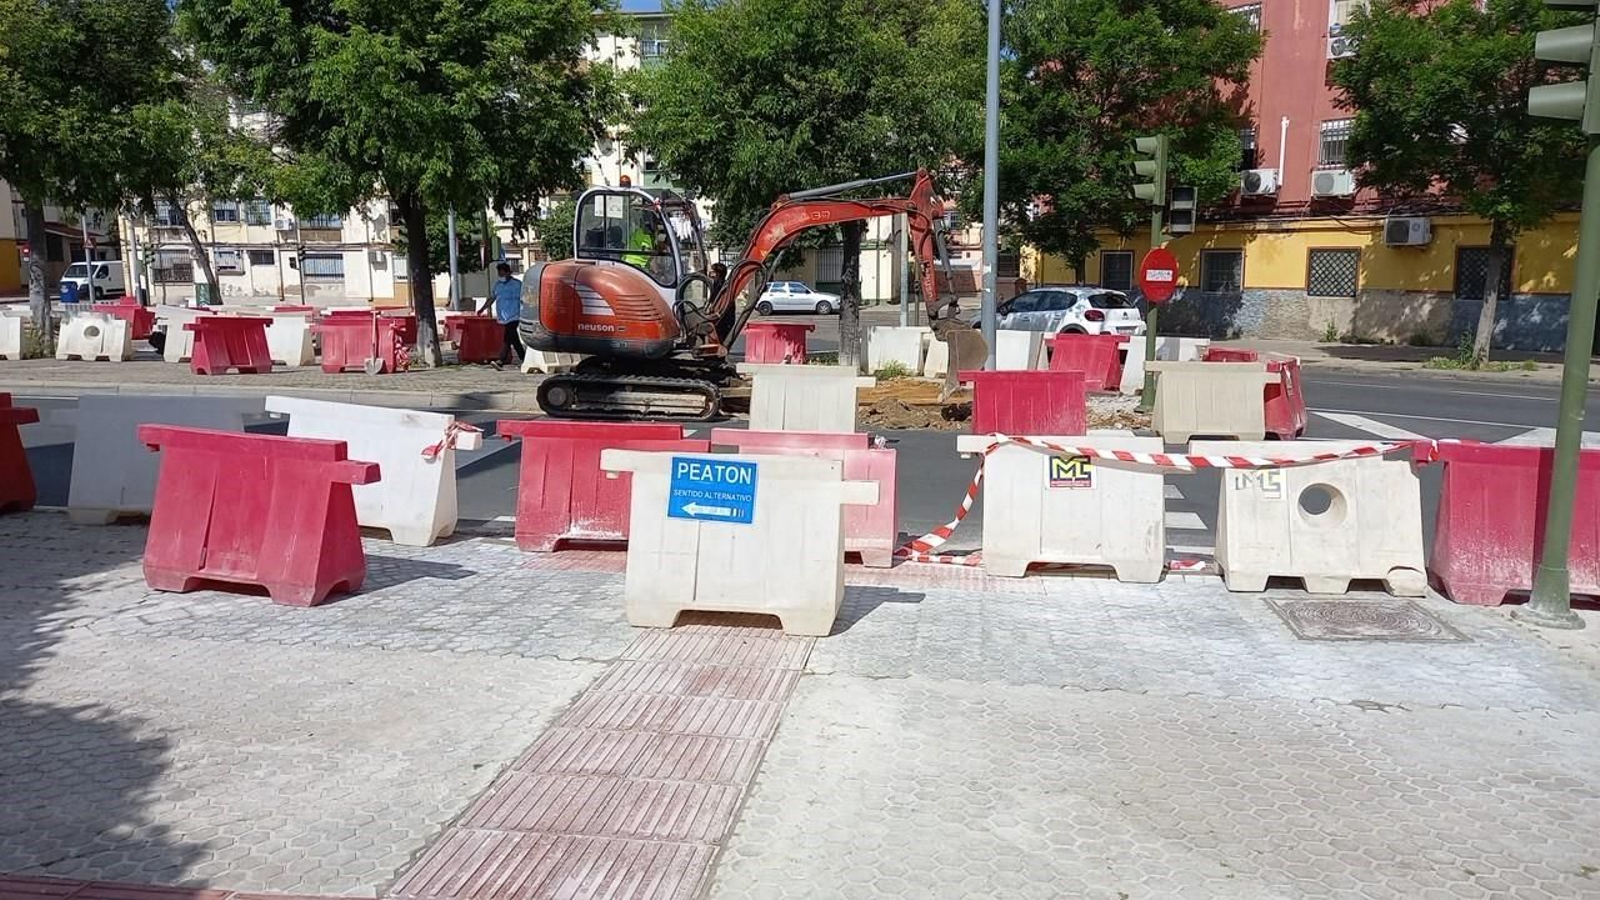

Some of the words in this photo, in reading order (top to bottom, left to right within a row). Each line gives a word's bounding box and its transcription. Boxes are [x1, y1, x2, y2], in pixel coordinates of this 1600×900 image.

[578, 323, 615, 332] neuson
[677, 462, 752, 484] PEATON
[673, 489, 704, 499] SENTIDO
[704, 490, 752, 502] ALTERNATIVO
